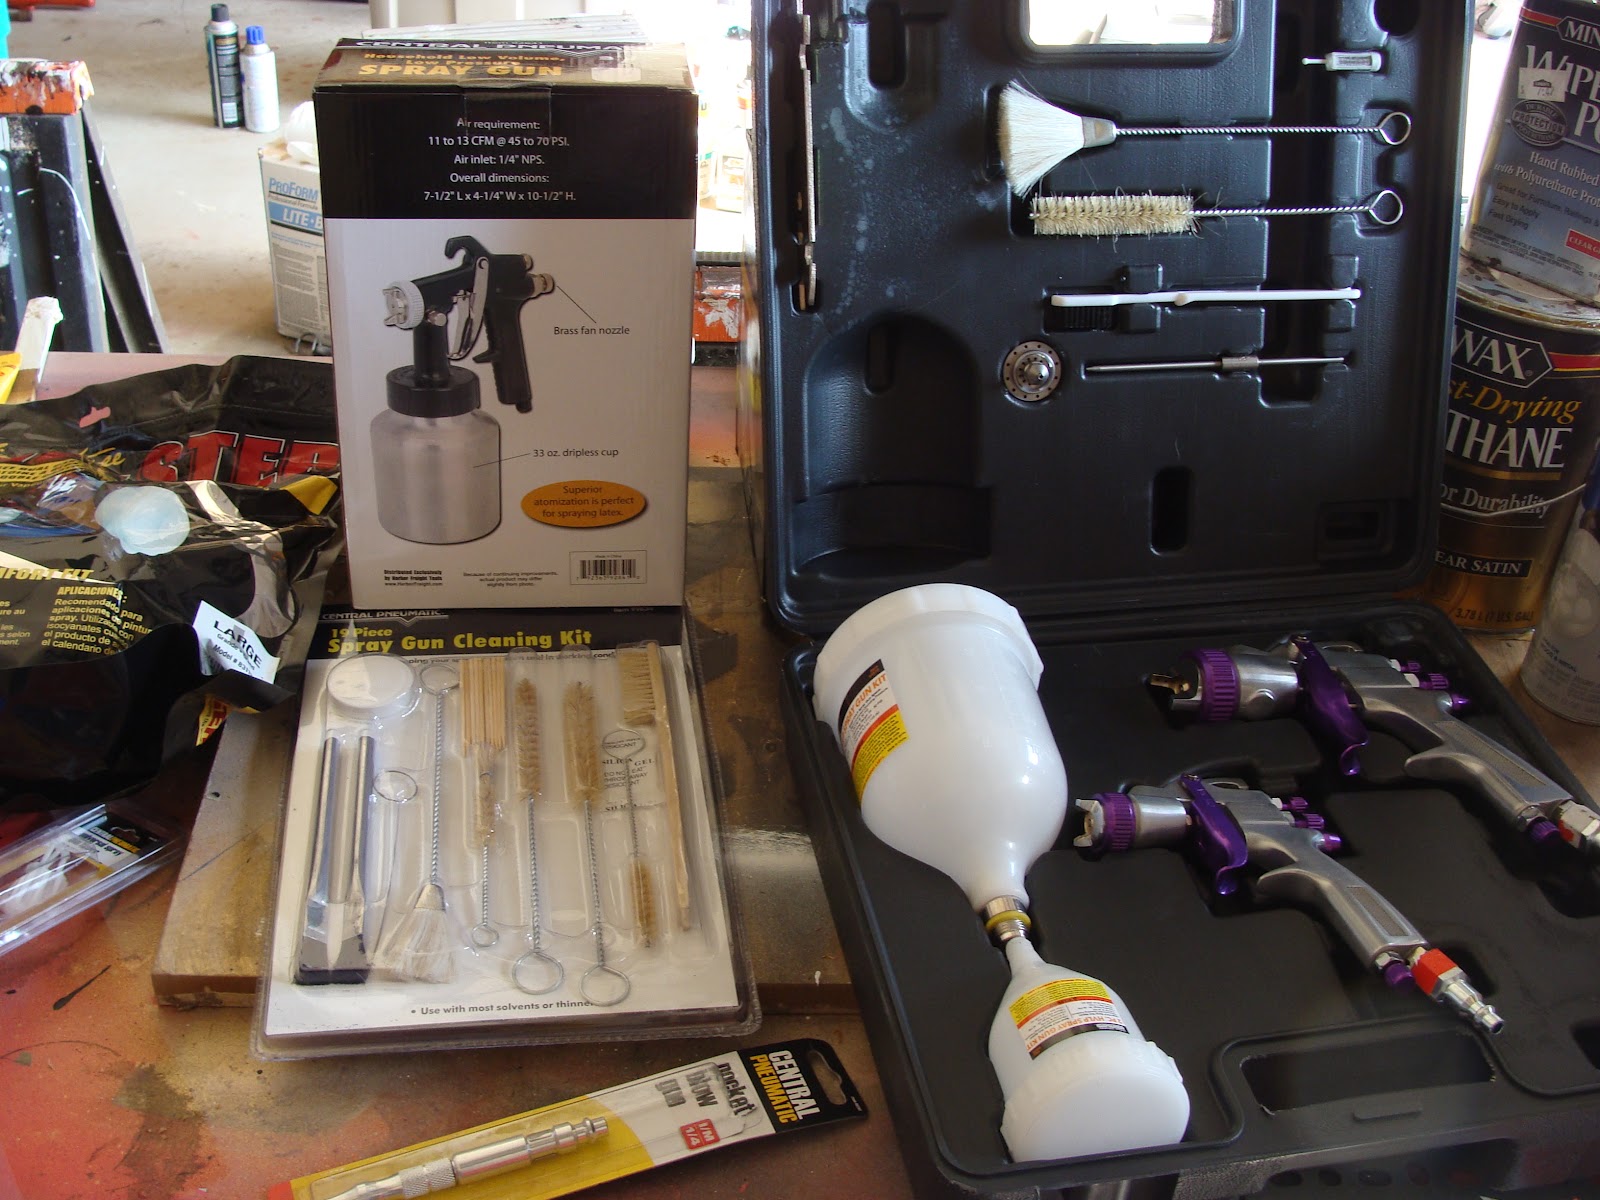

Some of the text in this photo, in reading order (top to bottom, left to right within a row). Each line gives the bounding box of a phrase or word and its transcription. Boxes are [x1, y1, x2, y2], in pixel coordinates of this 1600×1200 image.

[358, 64, 562, 76] SPRAY GUN
[457, 117, 541, 131] Air requirement:
[1513, 111, 1564, 133] PROTECTION
[428, 136, 570, 147] 11 to 13 CFM @ 45 to 70 PSI.
[454, 154, 545, 165] Air inlet: 1/4" NPS.
[1529, 151, 1600, 187] Hand Rubbed
[450, 172, 550, 183] Overall dimensions:
[1494, 163, 1578, 198] with Polyurethane
[424, 191, 577, 201] 7-1/2" L x 4-1/4" W x 10-1/2" H.
[1492, 195, 1539, 219] Easy to Apply
[283, 207, 310, 227] LITE
[1488, 208, 1529, 230] Fast Drying
[1568, 235, 1592, 251] CLEAR
[553, 326, 630, 335] Brass fan nozzle
[533, 449, 544, 458] 33
[562, 448, 599, 458] dripless
[601, 449, 619, 459] cup
[563, 486, 603, 495] Superior
[533, 496, 634, 507] atomization is perfect
[1462, 487, 1549, 519] Durability
[542, 509, 623, 520] for spraying latex.
[60, 568, 94, 580] FIT
[1471, 559, 1522, 575] SATIN
[57, 586, 128, 603] APLICACIONES:
[51, 606, 111, 618] aplicaciones
[111, 614, 122, 625] de
[54, 598, 143, 622] Recomendado para
[322, 609, 441, 620] CENTRAL PNEUMATIC
[1455, 607, 1477, 619] 3.78
[46, 622, 101, 634] isocyanates
[49, 614, 78, 623] spray.
[119, 629, 135, 641] con
[332, 627, 393, 638] 19 Piece
[54, 631, 96, 643] producto
[98, 636, 111, 645] de
[213, 620, 262, 668] LARGE
[328, 628, 593, 656] Spray Gun Cleaning Kit
[52, 639, 102, 654] calendario
[213, 644, 234, 661] Model
[854, 673, 887, 709] GUN KIT
[634, 758, 653, 767] GEL
[629, 772, 648, 780] AWAY
[421, 1000, 594, 1015] Use with most solvents or thinne
[1026, 1015, 1105, 1050] HVLP SPRAY GUN KIT
[685, 1068, 719, 1108] blow
[749, 1054, 799, 1124] PNEUMATIC
[768, 1050, 821, 1120] CENTRAL
[654, 1078, 687, 1109] gun
[684, 1126, 701, 1148] 1/4
